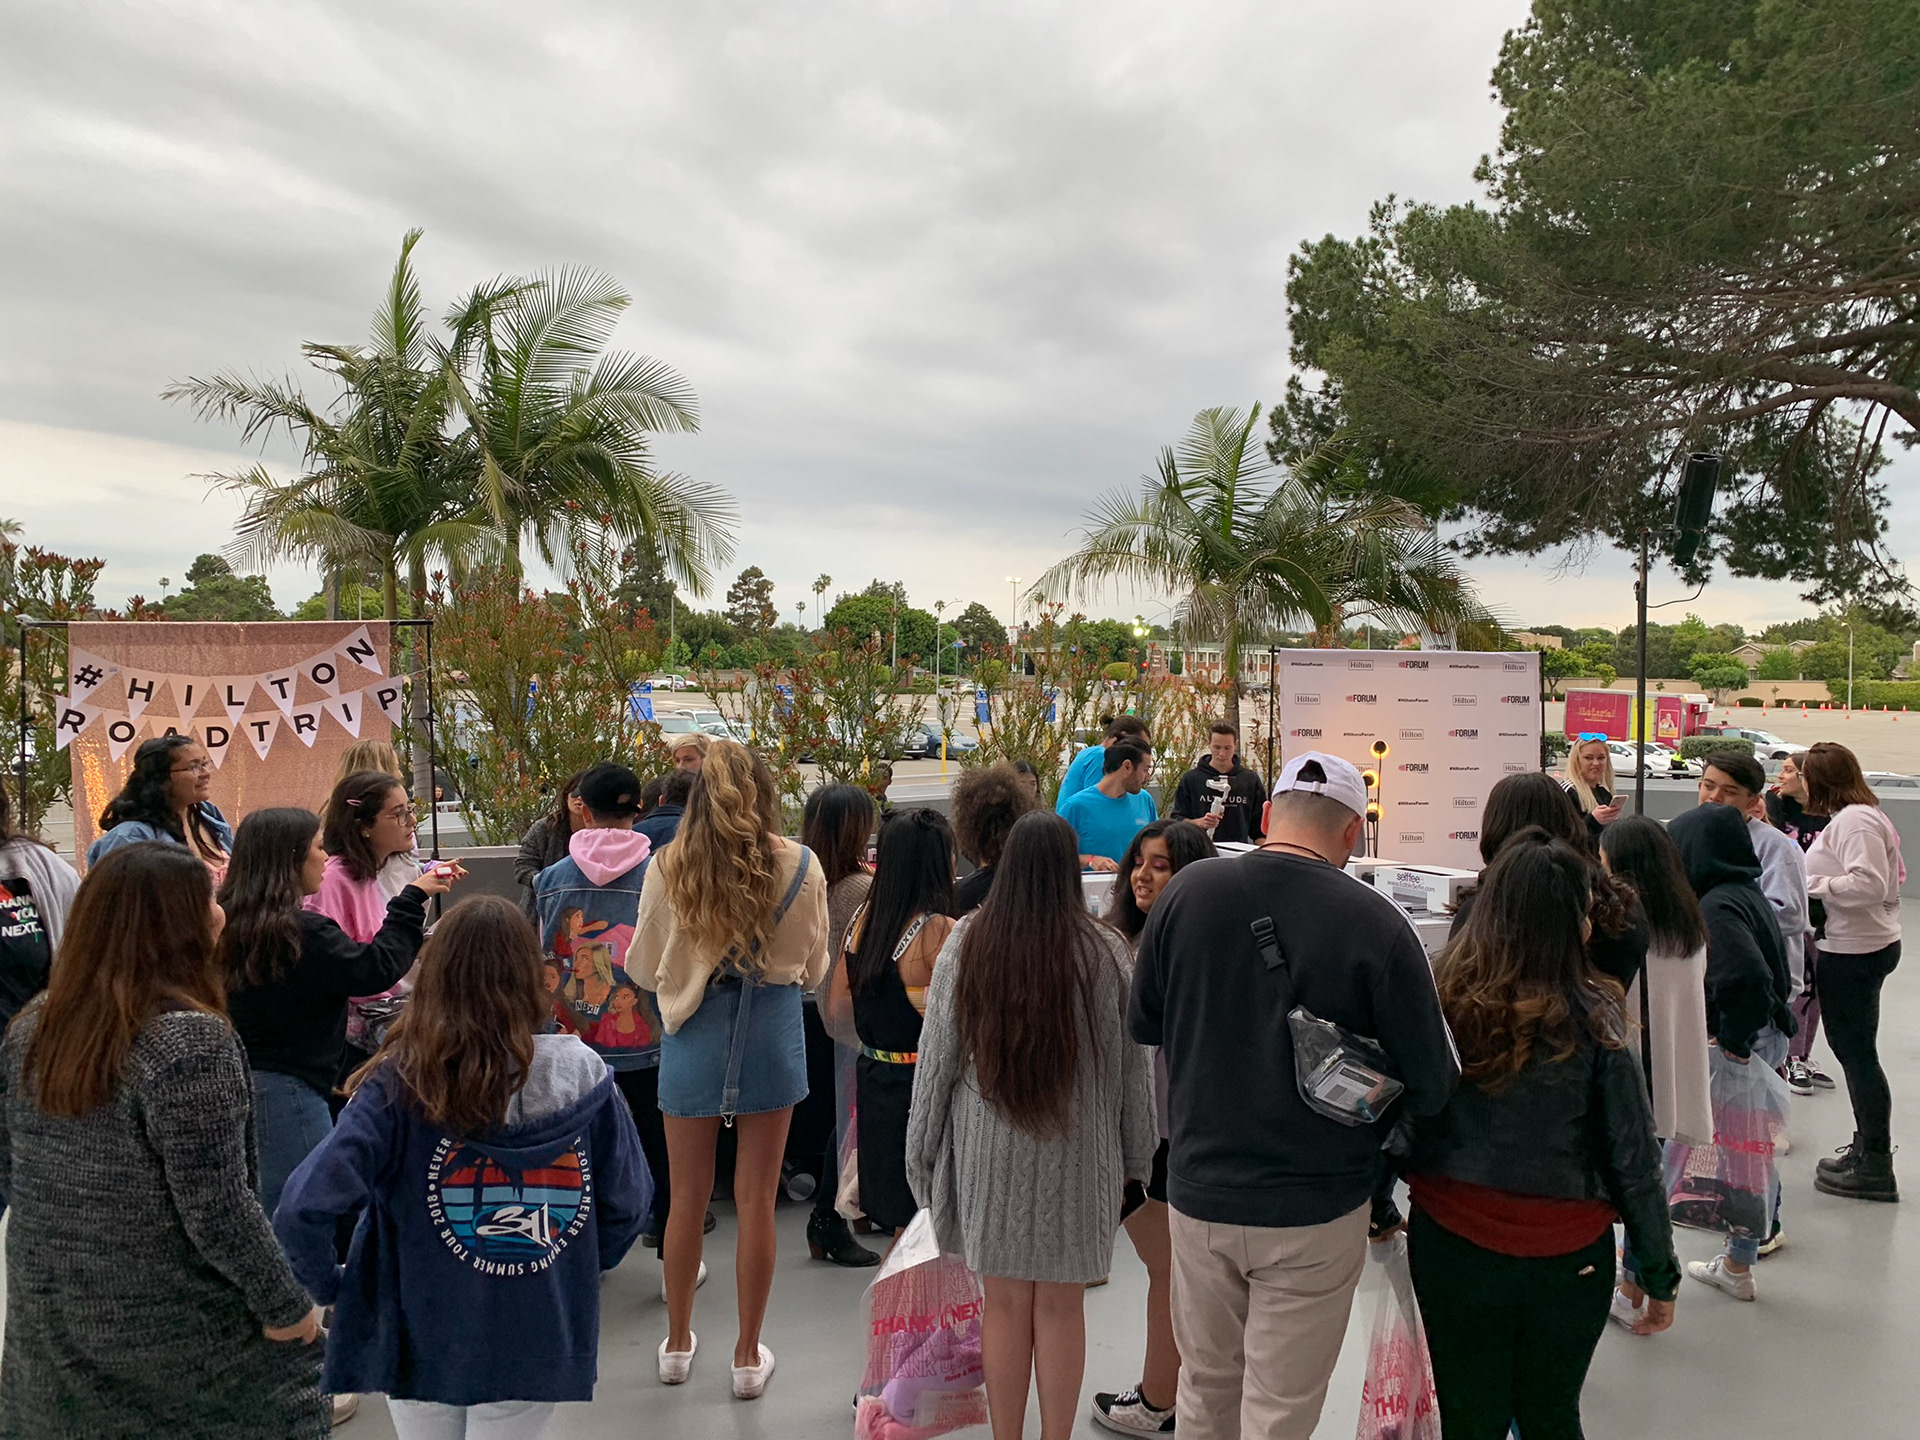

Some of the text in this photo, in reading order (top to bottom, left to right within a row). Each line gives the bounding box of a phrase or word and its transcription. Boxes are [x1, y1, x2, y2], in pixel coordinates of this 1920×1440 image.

[1405, 661, 1429, 669] FORUM
[1504, 663, 1525, 671] Hilton
[1297, 695, 1319, 703] Hilton
[1353, 694, 1377, 703] FORUM
[1506, 696, 1530, 704] FORUM
[1297, 729, 1322, 737] FORUM
[1455, 729, 1478, 737] FORUM
[1405, 763, 1429, 771] FORUM
[1504, 764, 1525, 772] Hilton
[1199, 794, 1247, 804] ALUDE
[1455, 831, 1479, 839] FORUM
[12, 907, 39, 920] YOU
[576, 1000, 600, 1015] NEXT
[427, 1137, 592, 1276] 2018 NEVER ENDING SUMMER TOUR 2018 NEVER
[871, 1314, 936, 1336] THANK
[951, 1296, 983, 1326] NEXT
